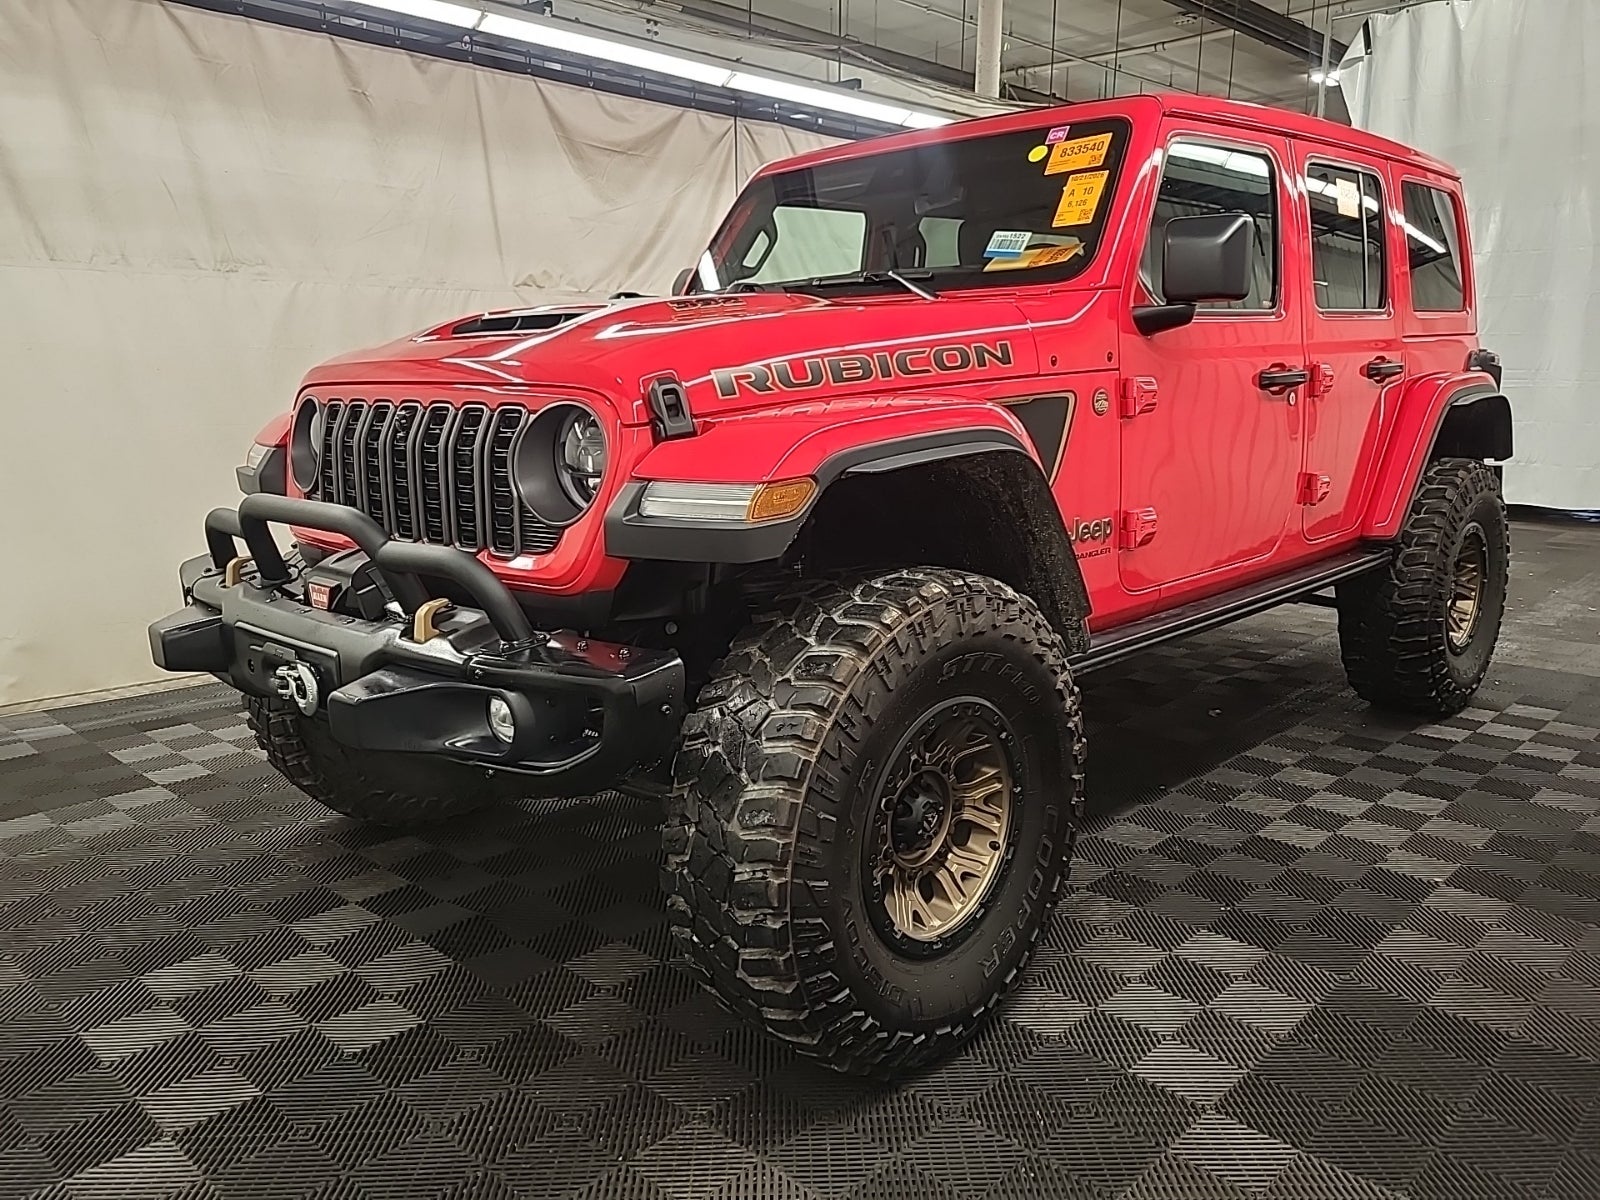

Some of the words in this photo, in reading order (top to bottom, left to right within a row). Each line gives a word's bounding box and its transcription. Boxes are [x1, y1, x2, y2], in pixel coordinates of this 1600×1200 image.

[1050, 131, 1065, 140] CR
[1060, 140, 1105, 158] 833540
[1068, 188, 1075, 197] A
[1083, 186, 1094, 196] 10
[710, 340, 1016, 399] RUBICON
[1068, 516, 1113, 545] Jeep
[1075, 547, 1111, 559] ANGLER
[937, 651, 1005, 684] STT
[977, 804, 1059, 978] COOPER
